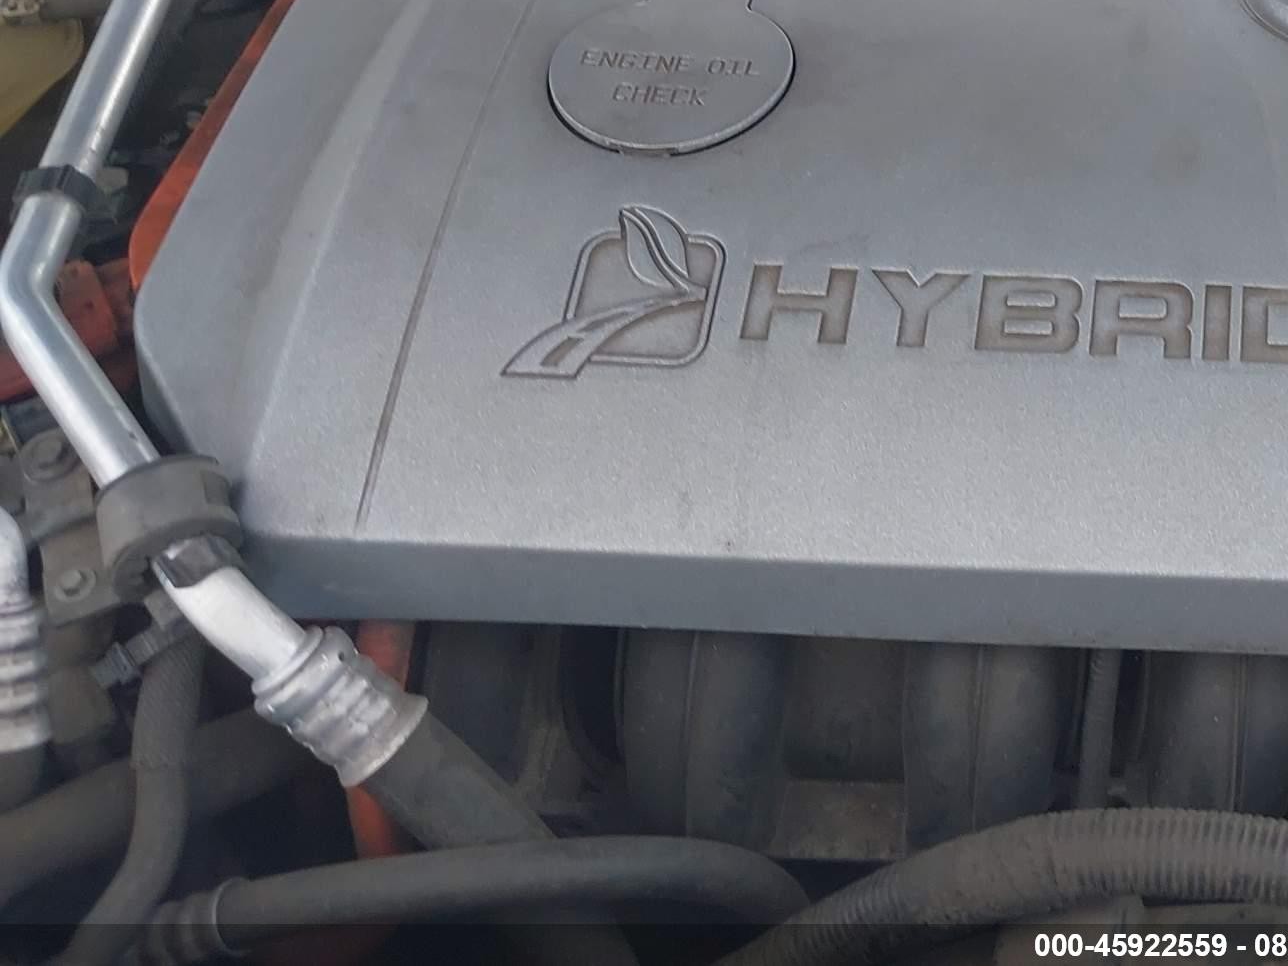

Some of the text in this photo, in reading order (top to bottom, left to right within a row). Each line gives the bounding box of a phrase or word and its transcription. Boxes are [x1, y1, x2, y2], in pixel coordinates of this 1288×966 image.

[580, 48, 761, 76] ENGINE OIL
[612, 82, 708, 107] CHECK
